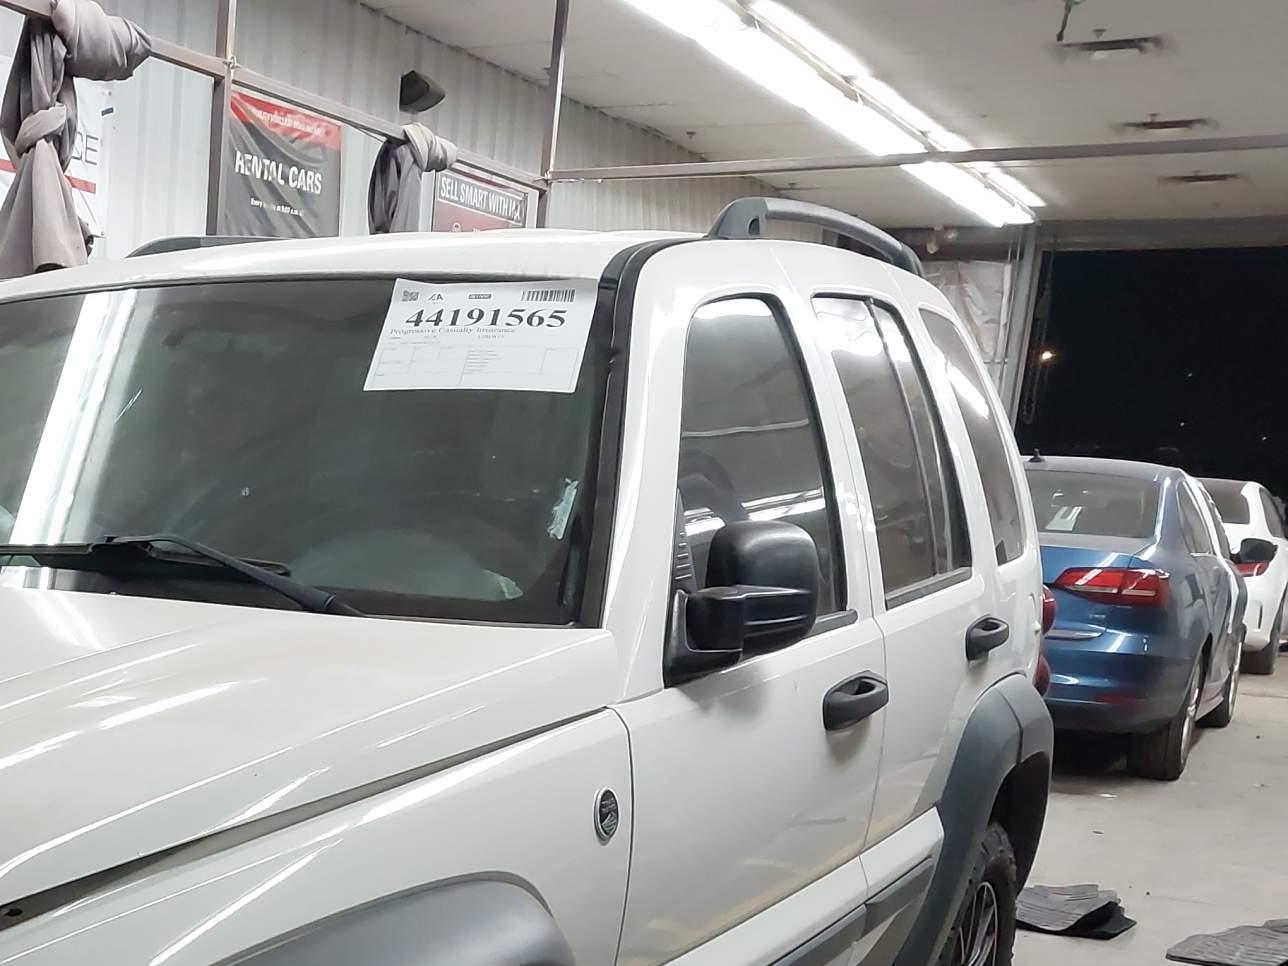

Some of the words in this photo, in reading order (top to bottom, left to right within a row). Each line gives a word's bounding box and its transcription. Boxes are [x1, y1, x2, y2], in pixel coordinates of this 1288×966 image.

[234, 150, 285, 185] RENTAL
[288, 166, 322, 194] CARS
[440, 176, 459, 201] SELL
[459, 183, 489, 209] SMART
[488, 192, 509, 217] WITH
[405, 308, 568, 328] 44191565
